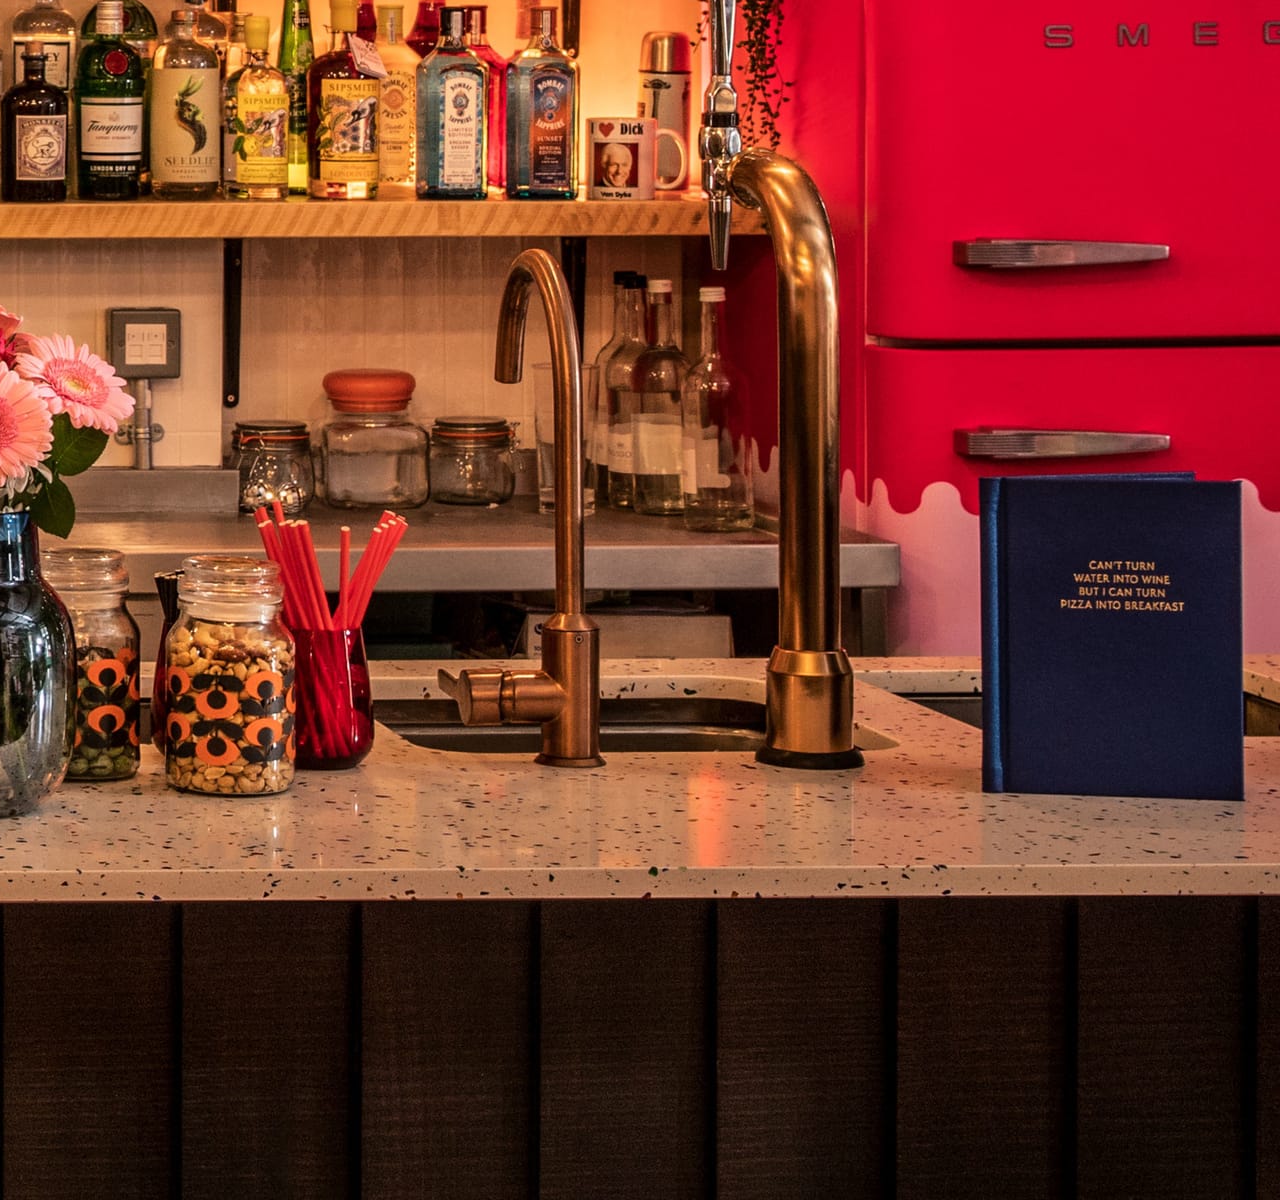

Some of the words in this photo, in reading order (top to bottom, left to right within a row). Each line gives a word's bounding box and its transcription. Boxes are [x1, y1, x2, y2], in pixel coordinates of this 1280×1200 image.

[1044, 20, 1280, 49] SMEG
[329, 82, 378, 92] SIPSMITH
[382, 78, 407, 90] BOMBAY
[450, 82, 473, 92] BOMBAY
[537, 78, 565, 91] BOMBAY
[243, 97, 286, 105] SIPSMITH
[449, 115, 473, 125] SAPPHIRE
[535, 118, 566, 131] SAPPHIRE
[87, 120, 139, 135] Tanqueray
[620, 122, 644, 136] Dick
[1088, 560, 1122, 570] CAN'T
[1125, 561, 1155, 571] TURN
[1073, 573, 1110, 583] WATER
[1113, 574, 1139, 584] INTO
[1141, 575, 1171, 585] WINE
[1079, 587, 1099, 596] BUT
[1102, 587, 1106, 596] I
[1108, 587, 1133, 597] CAN
[1136, 588, 1166, 598] TURN
[1060, 599, 1092, 609] PIZZA
[1095, 600, 1122, 610] INTO
[1125, 601, 1185, 612] BREAKFAST
